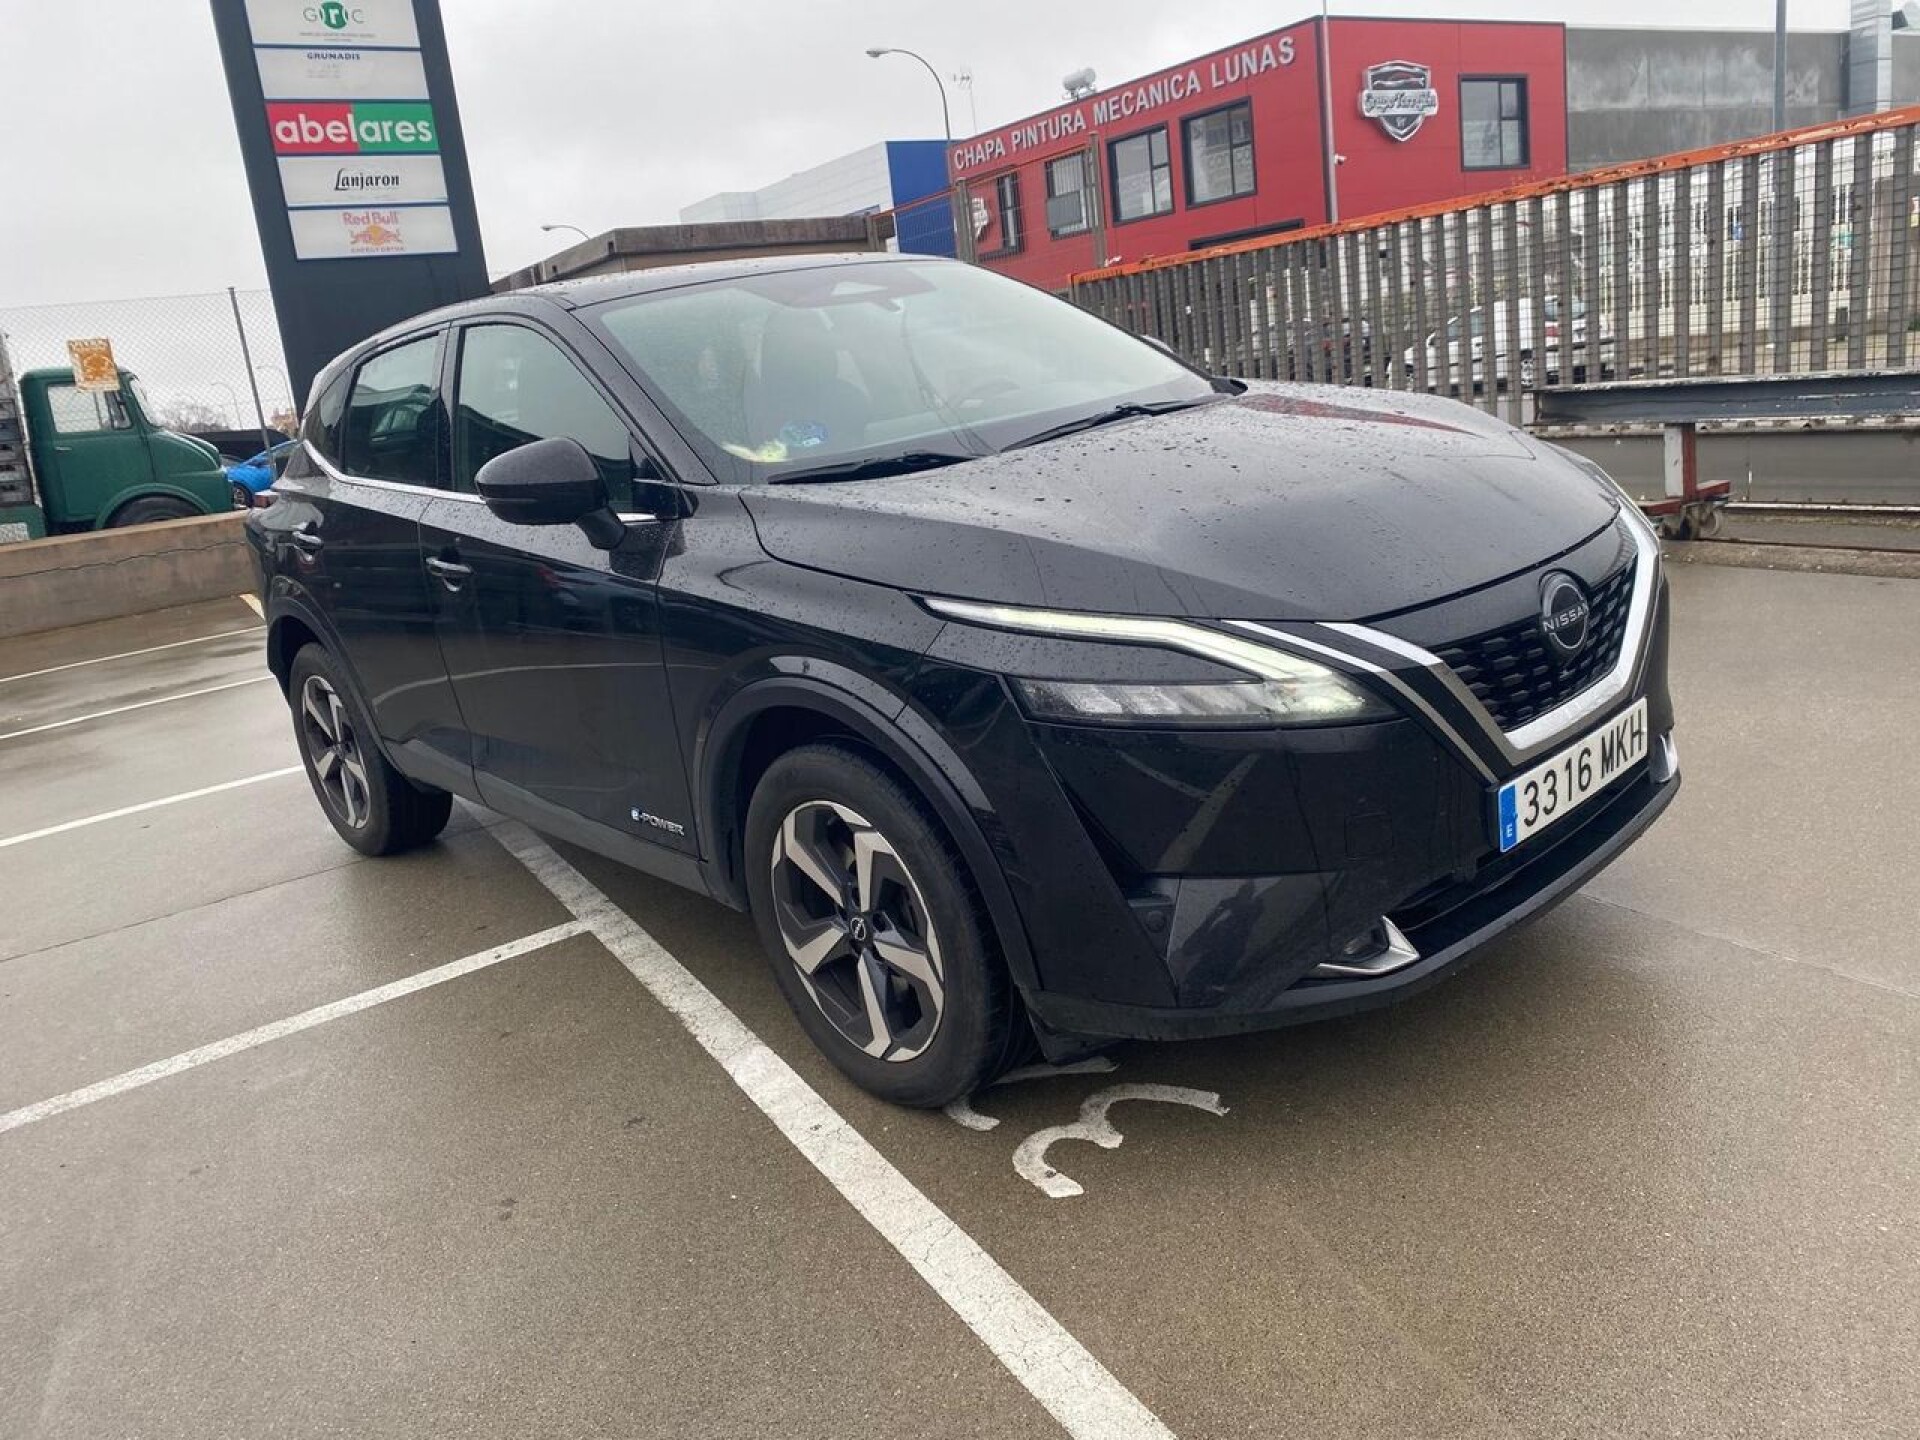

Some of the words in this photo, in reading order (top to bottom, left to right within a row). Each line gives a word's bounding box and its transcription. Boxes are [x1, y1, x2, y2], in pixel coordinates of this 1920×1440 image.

[953, 137, 1006, 171] CHAPA
[1011, 110, 1087, 152] PINTURA
[1093, 70, 1202, 126] MECANICA
[1211, 36, 1296, 88] LUNAS
[275, 113, 433, 144] abelares
[334, 168, 400, 191] Lanjaron
[342, 212, 370, 226] Red
[372, 210, 399, 224] Bull
[1523, 748, 1593, 828] 3316
[1600, 709, 1643, 779] MKH
